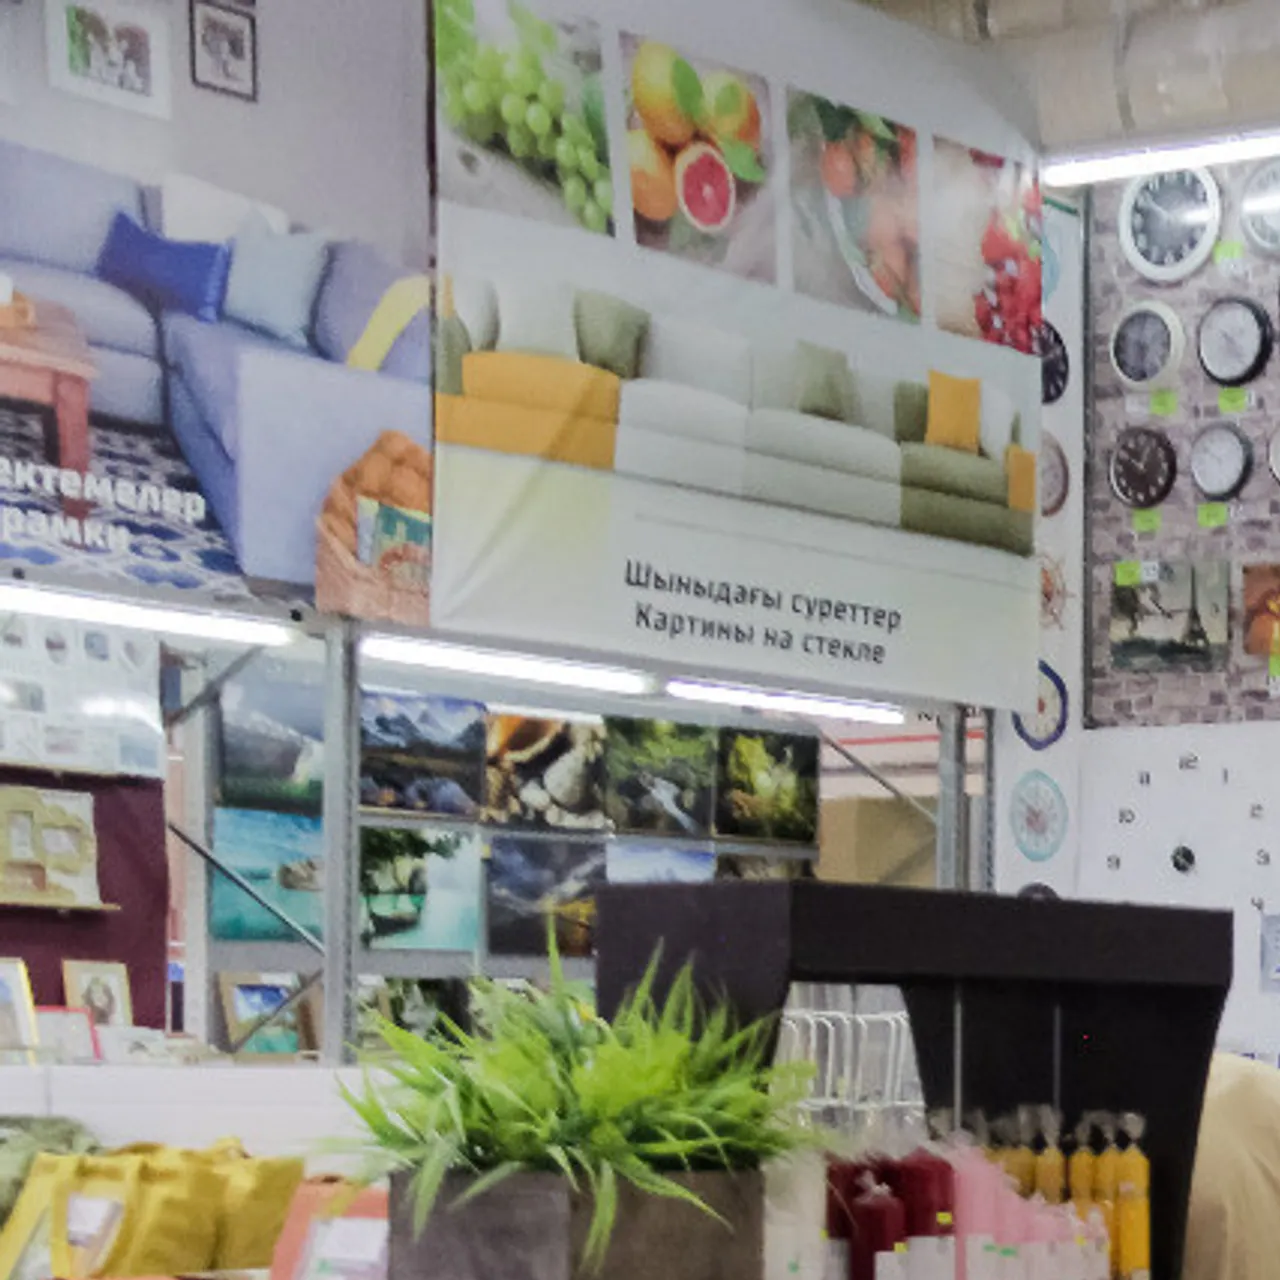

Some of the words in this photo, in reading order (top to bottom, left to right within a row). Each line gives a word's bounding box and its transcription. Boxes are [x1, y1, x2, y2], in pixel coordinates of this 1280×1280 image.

[625, 559, 782, 609] Шыныдағы
[791, 594, 901, 634] суреттер
[635, 603, 754, 644] Картины
[764, 629, 793, 650] на
[803, 634, 886, 664] стекле
